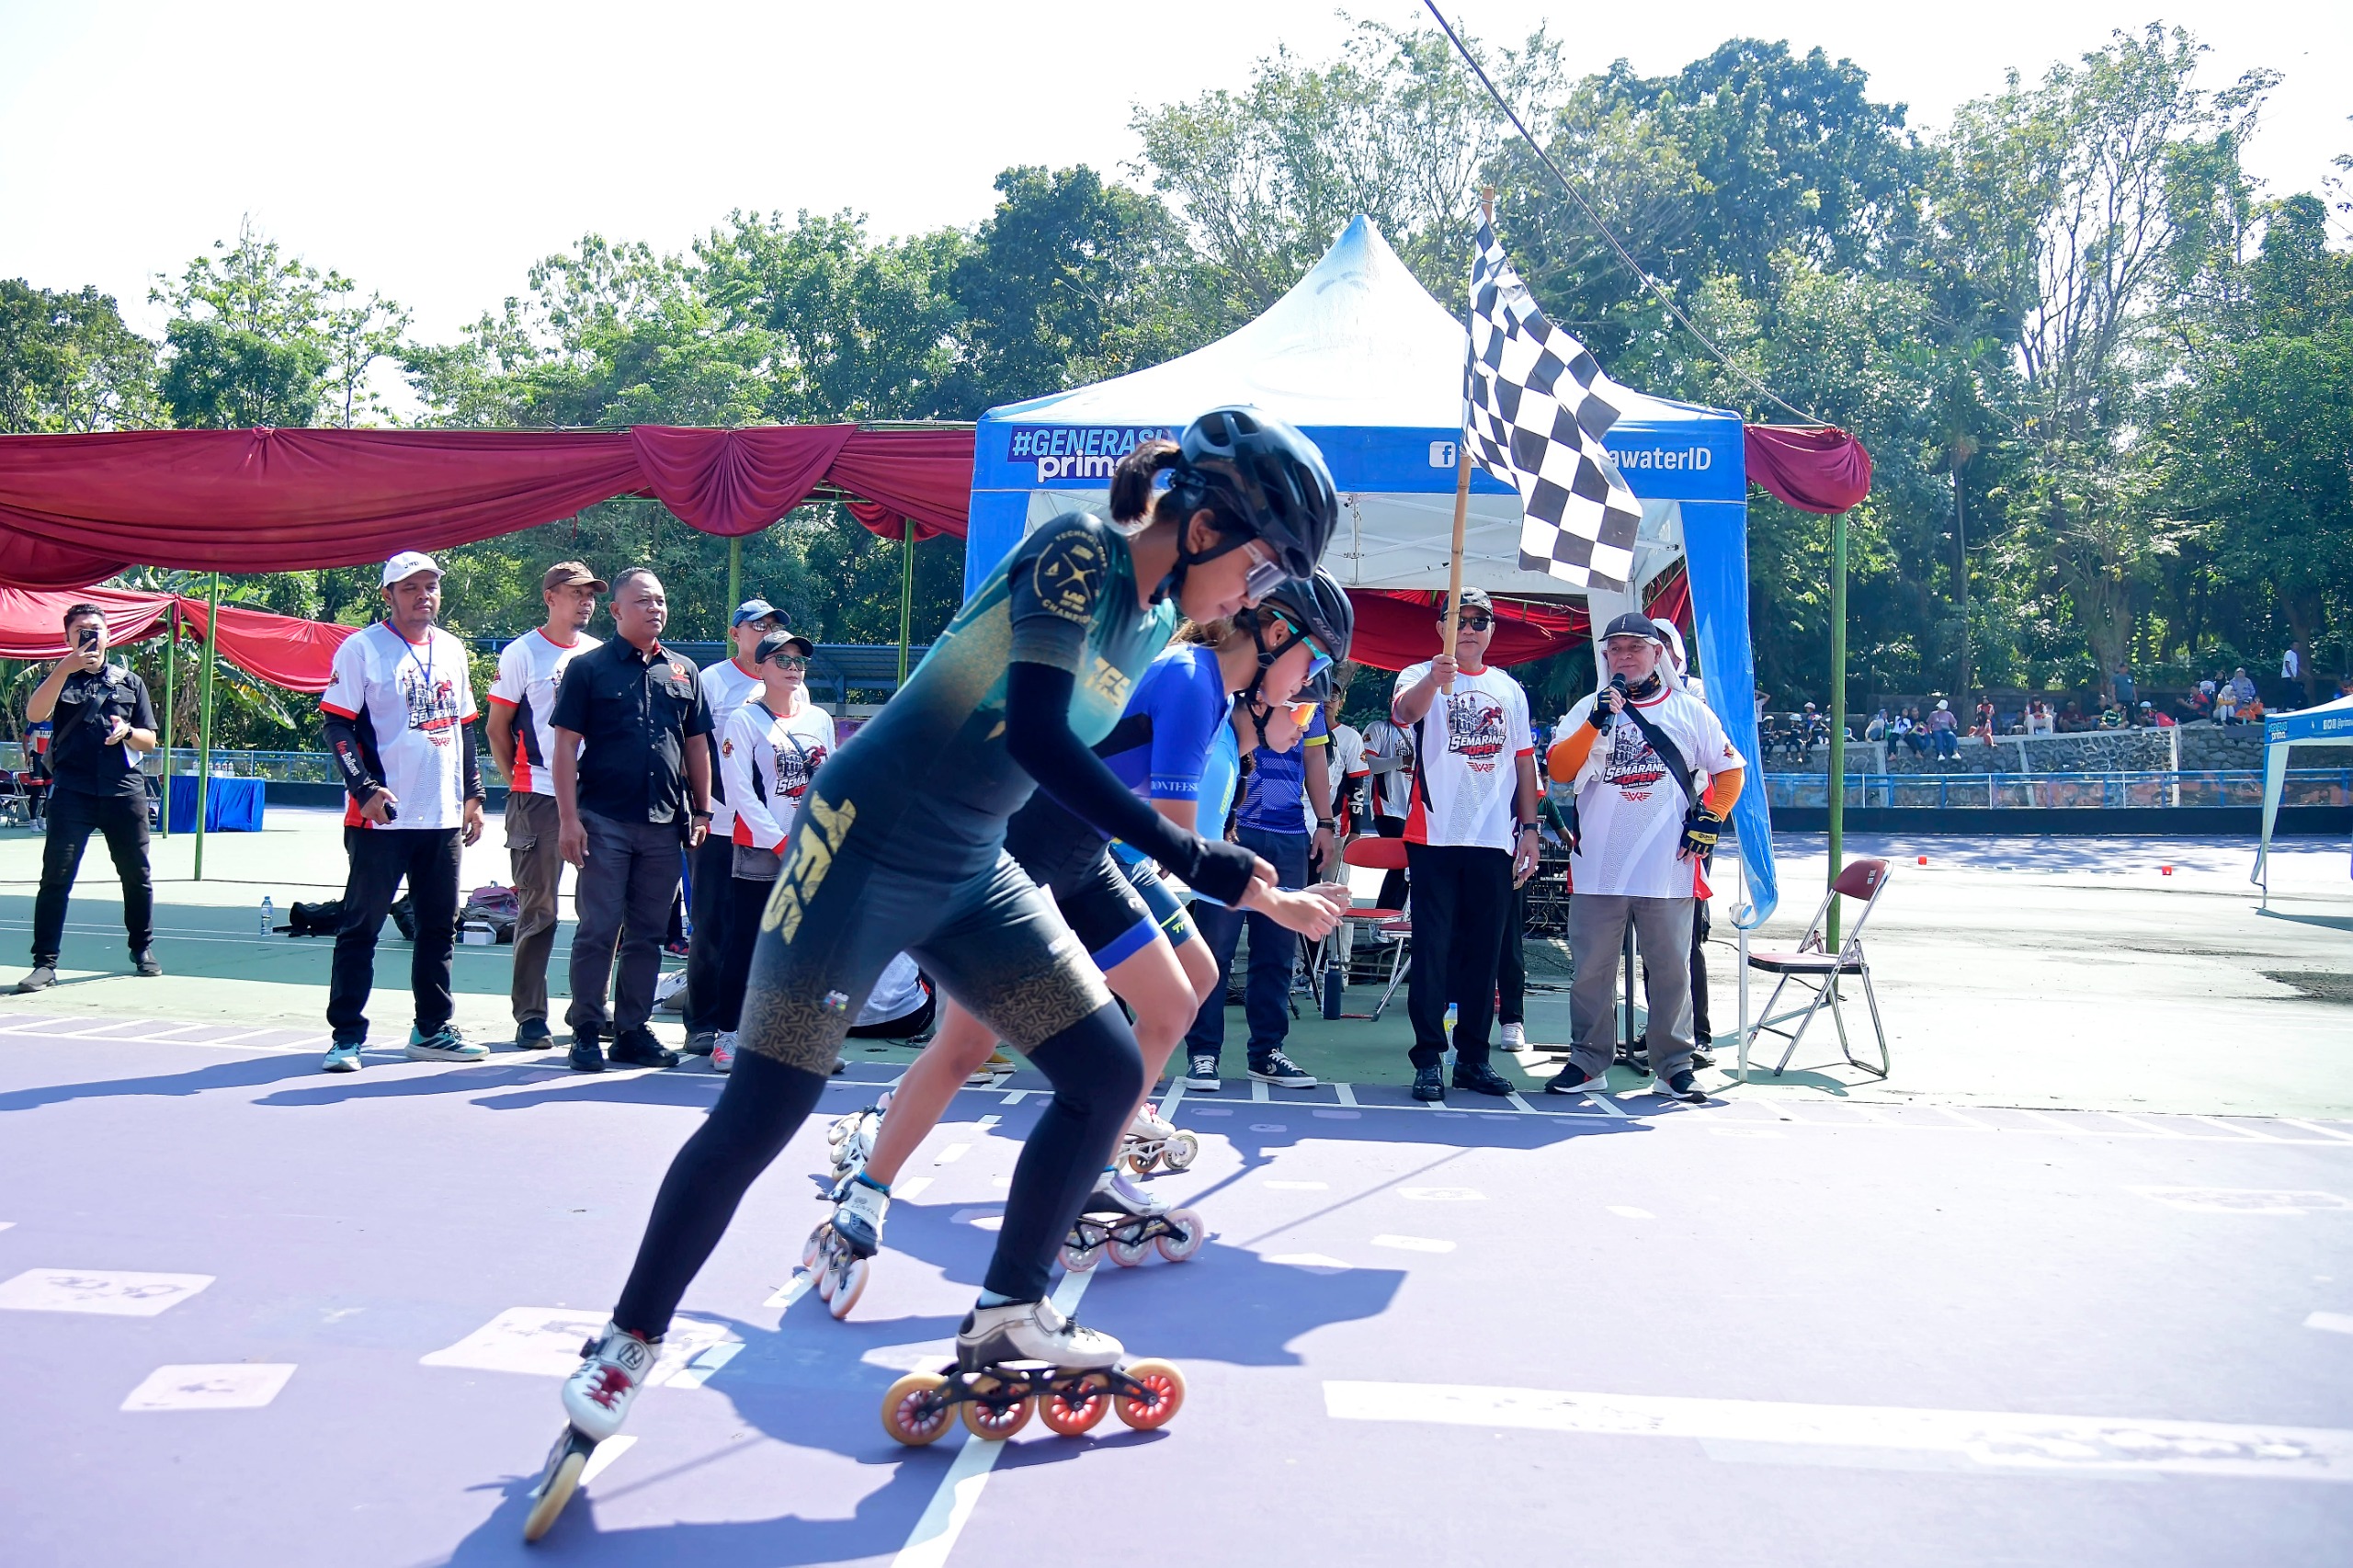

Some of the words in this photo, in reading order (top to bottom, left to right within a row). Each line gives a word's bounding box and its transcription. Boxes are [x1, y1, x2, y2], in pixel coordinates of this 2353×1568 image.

[1038, 449, 1127, 483] prim
[1449, 734, 1506, 751] SEMARANG
[1468, 744, 1496, 756] OPEN
[1604, 763, 1665, 781] SEMARANG
[1621, 772, 1658, 785] OPEN
